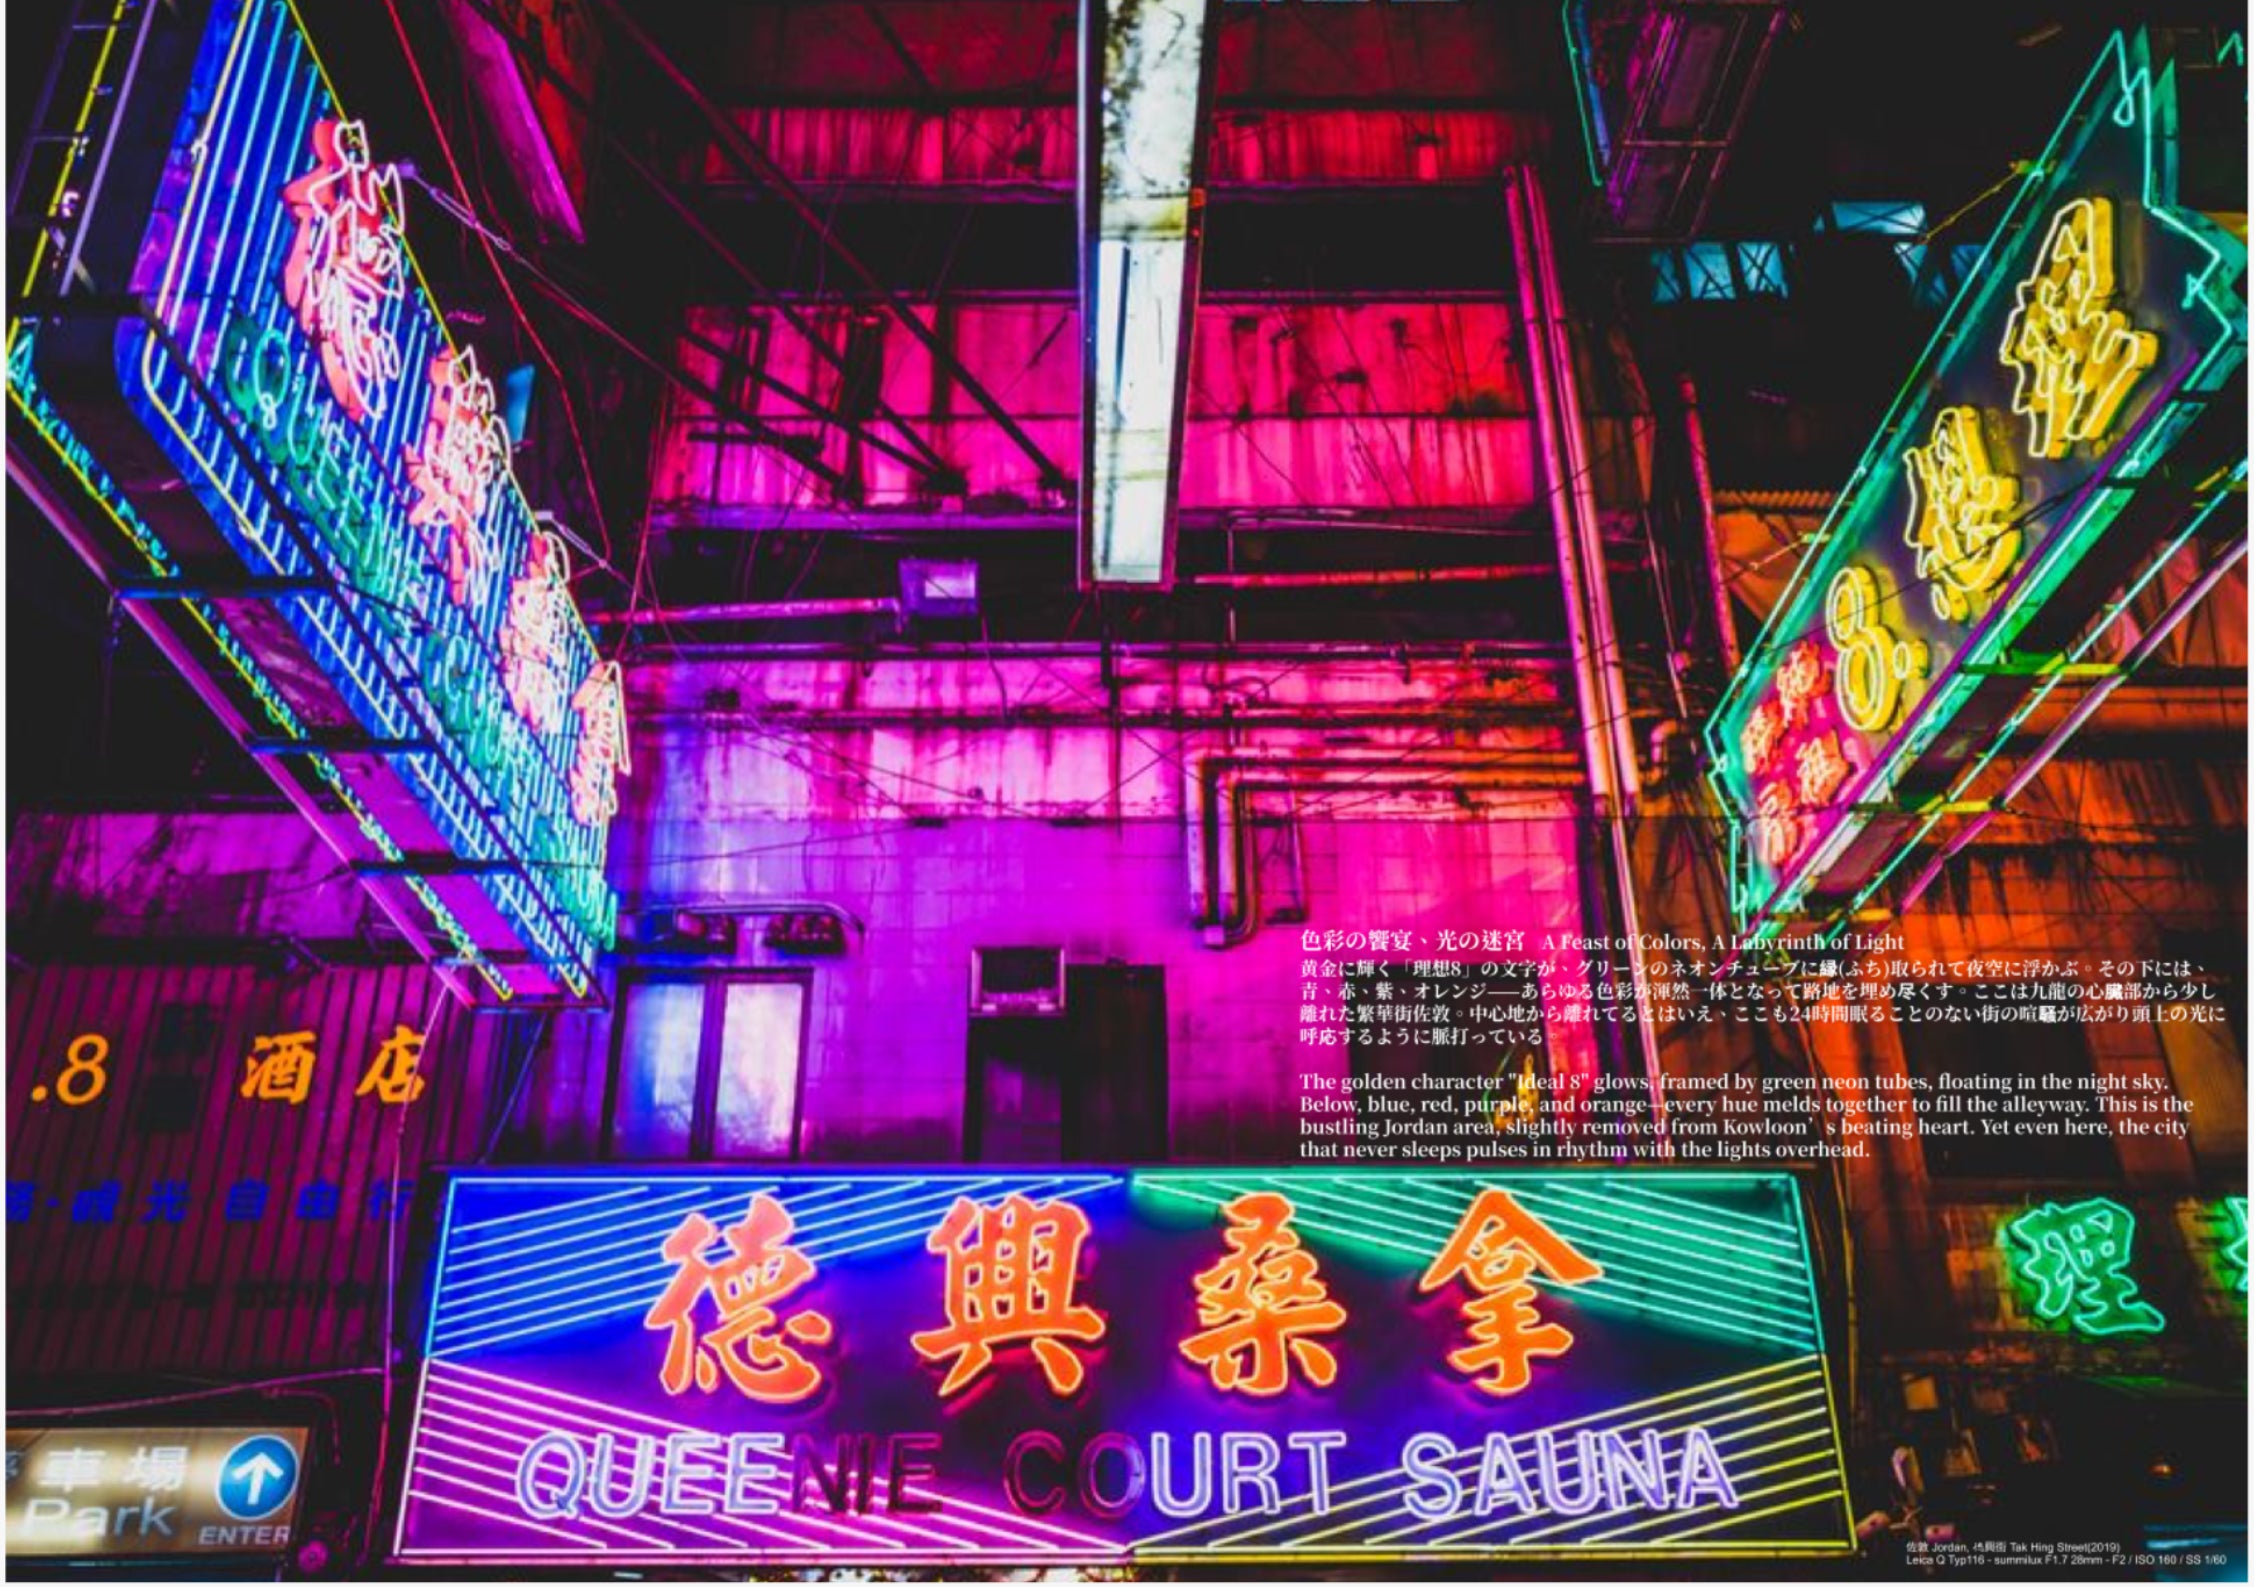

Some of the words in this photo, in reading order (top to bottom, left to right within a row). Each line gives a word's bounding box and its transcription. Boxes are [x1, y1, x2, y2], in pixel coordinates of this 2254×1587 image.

[240, 1025, 426, 1104] 酒店
[644, 1189, 1606, 1403] 德興桑拿
[515, 1430, 945, 1520] QUEENIE
[1001, 1430, 1348, 1519] COURT
[1402, 1428, 1741, 1514] SAUNA
[20, 1495, 177, 1538] Park
[198, 1525, 292, 1546] ENTER
